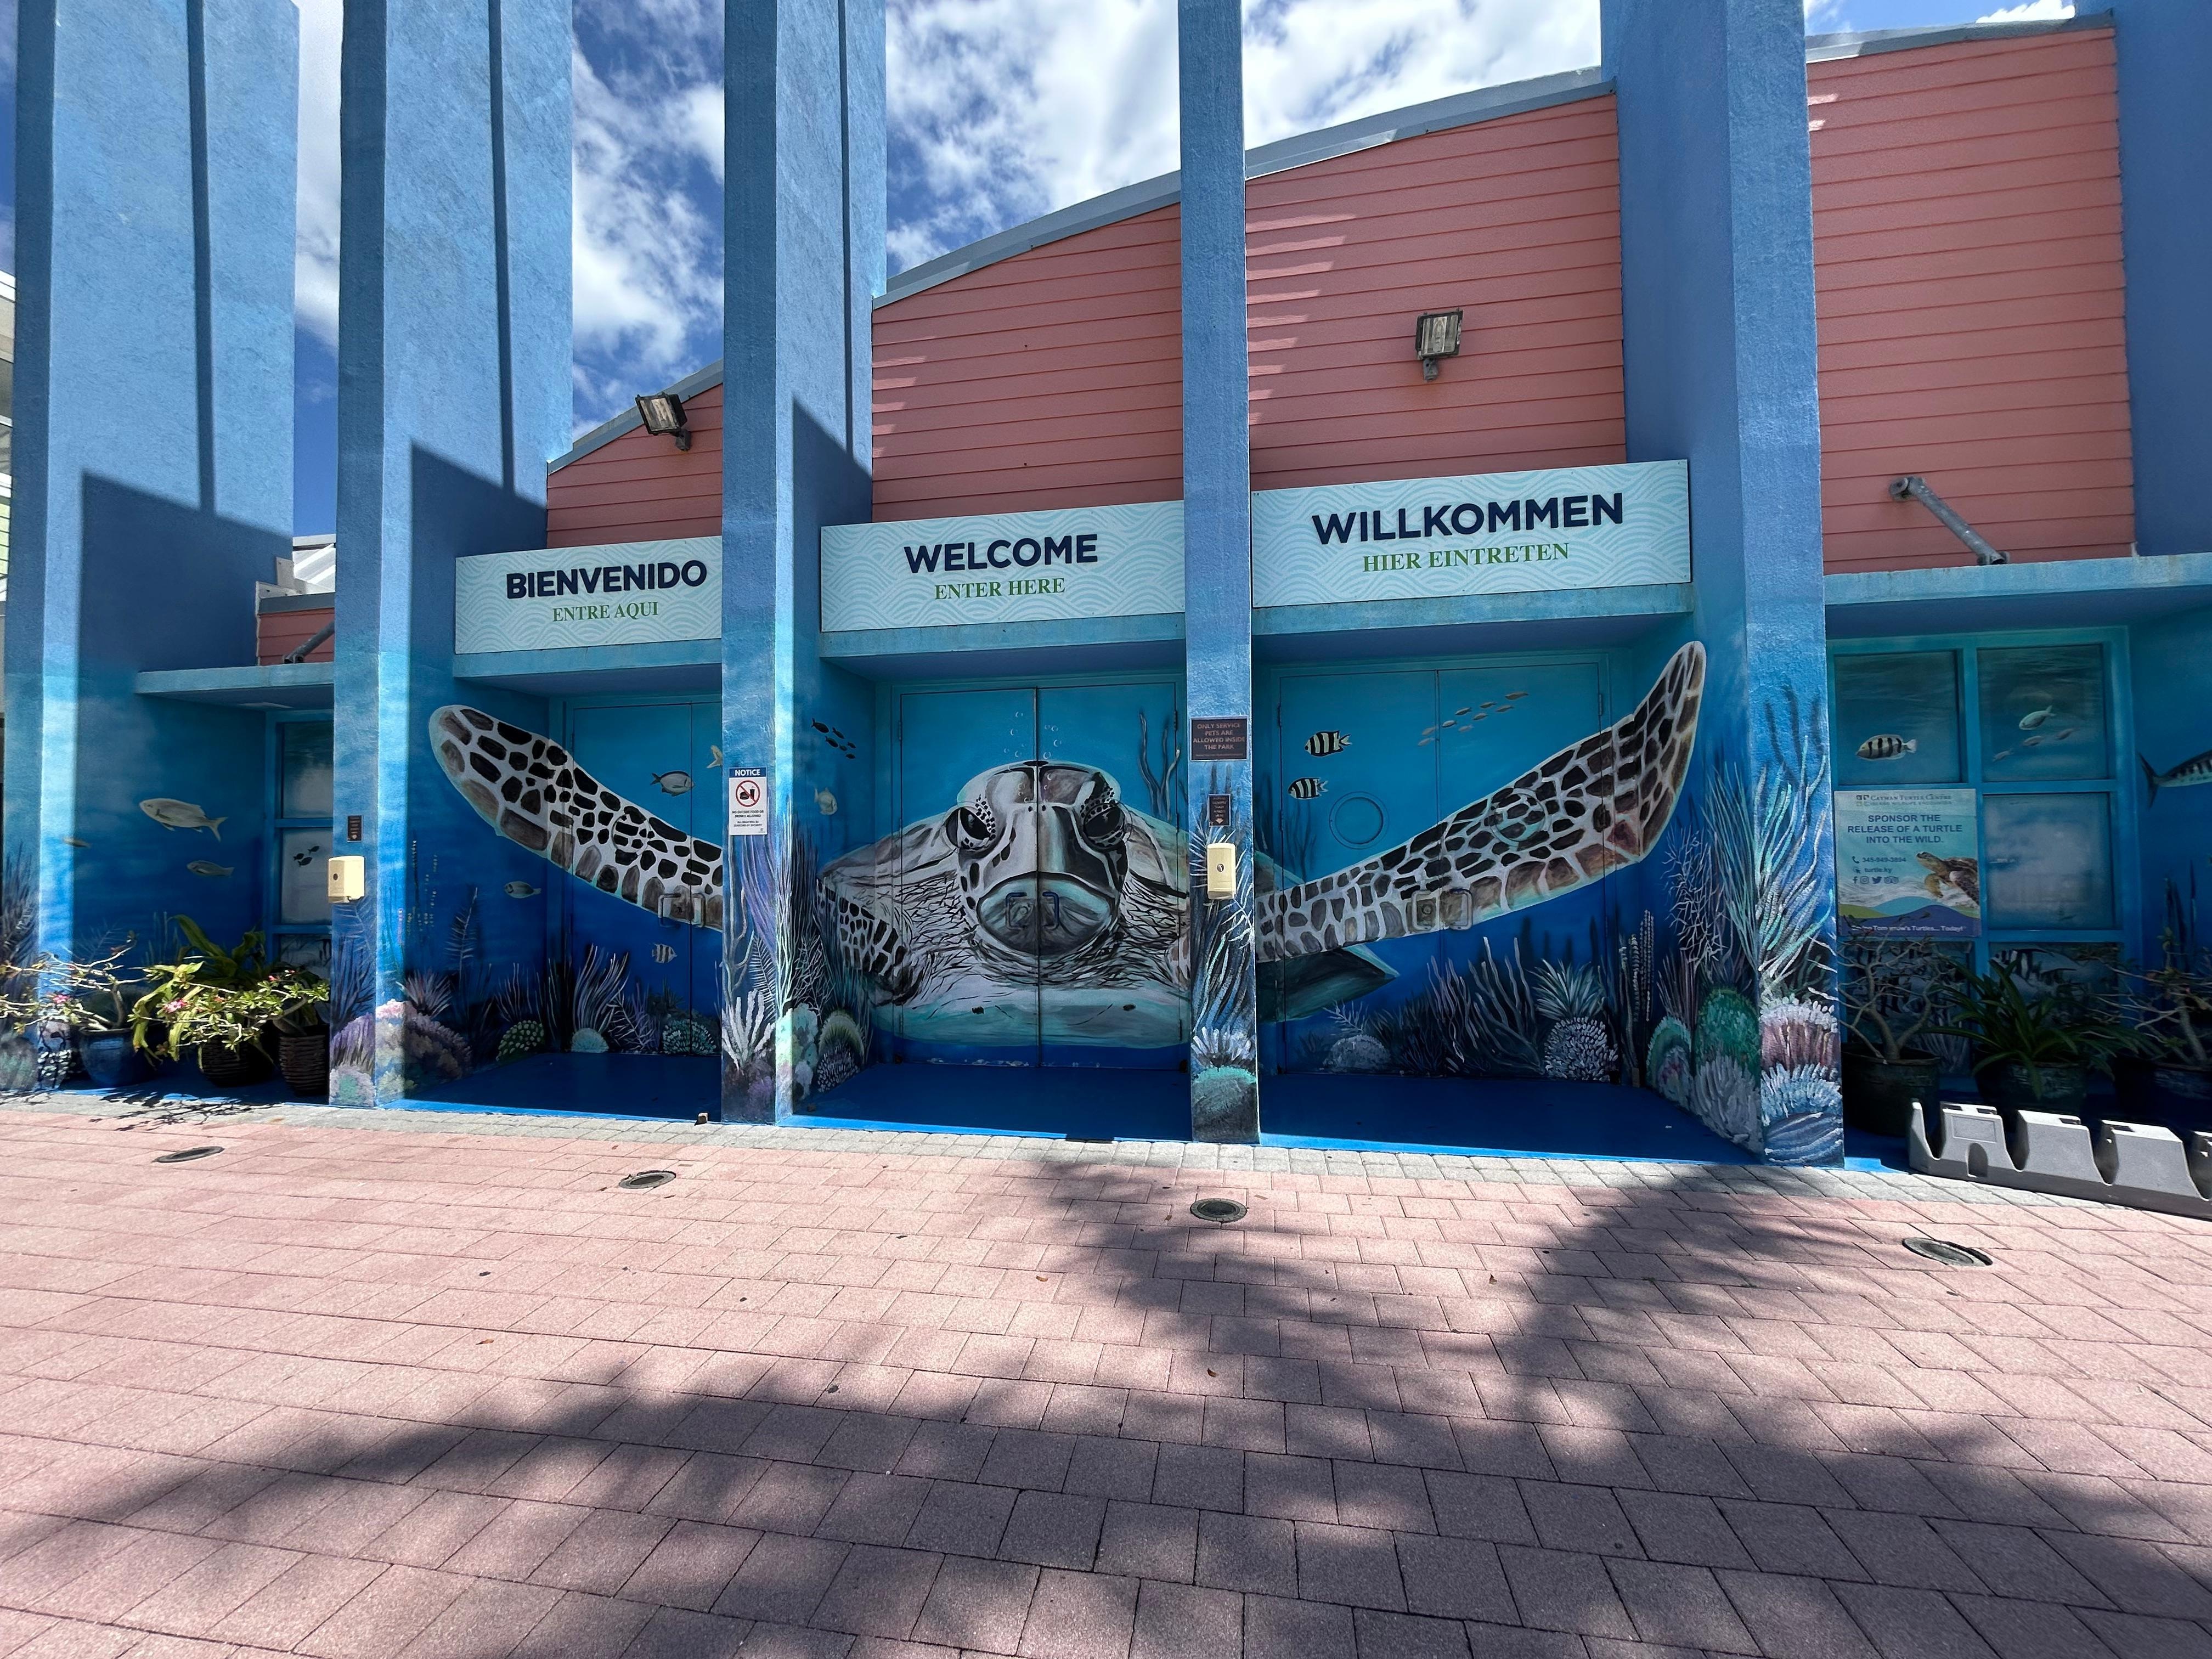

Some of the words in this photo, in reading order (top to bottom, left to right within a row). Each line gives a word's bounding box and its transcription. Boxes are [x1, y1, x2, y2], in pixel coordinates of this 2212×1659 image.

[1312, 493, 1623, 545] WILLKOMMEN
[904, 534, 1098, 573] WELCOME
[1363, 551, 1421, 573] HIER
[1427, 542, 1570, 568] EINTRETEN
[506, 560, 707, 599] BIENVENIDO
[934, 582, 1002, 600] ENTER
[1008, 577, 1066, 596] HERE
[552, 605, 610, 622] ENTRE
[614, 601, 658, 619] AQUI
